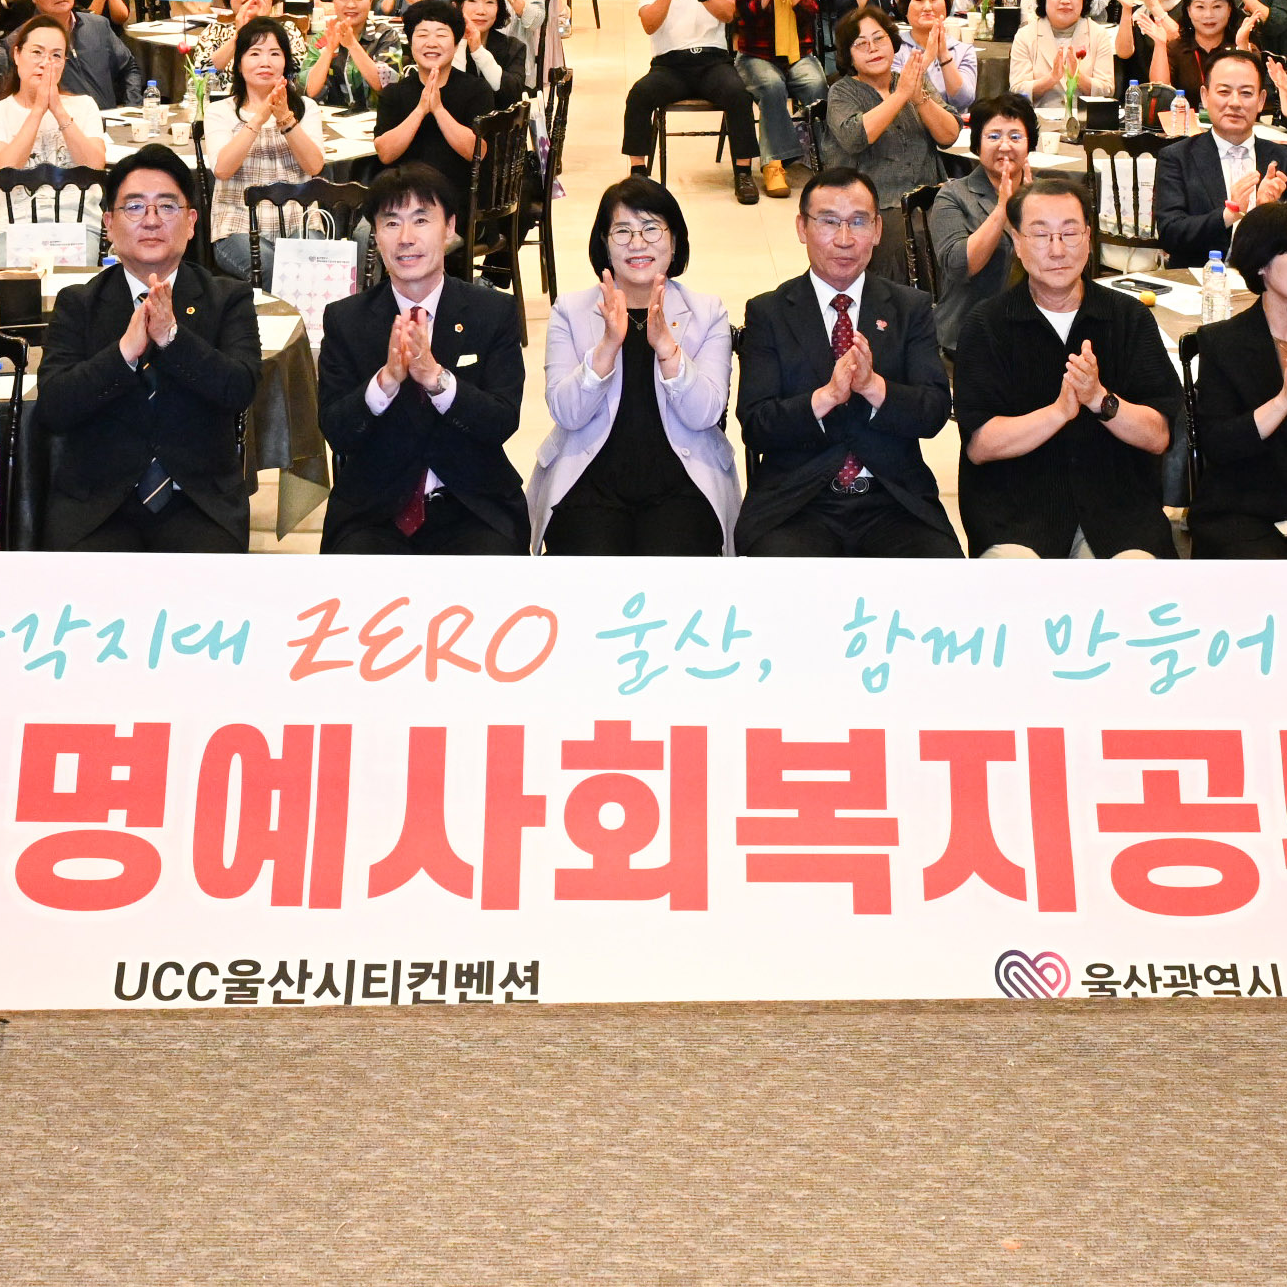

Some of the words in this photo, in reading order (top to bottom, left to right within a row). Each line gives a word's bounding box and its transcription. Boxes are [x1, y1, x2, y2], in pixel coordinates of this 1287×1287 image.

[287, 597, 558, 683] ZERO
[596, 592, 772, 696] 울산,
[843, 597, 1007, 694] 함께
[1045, 602, 1275, 696] 만들어
[115, 959, 540, 1006] UCC울산시티컨벤션
[1081, 963, 1283, 998] 울산광역시
